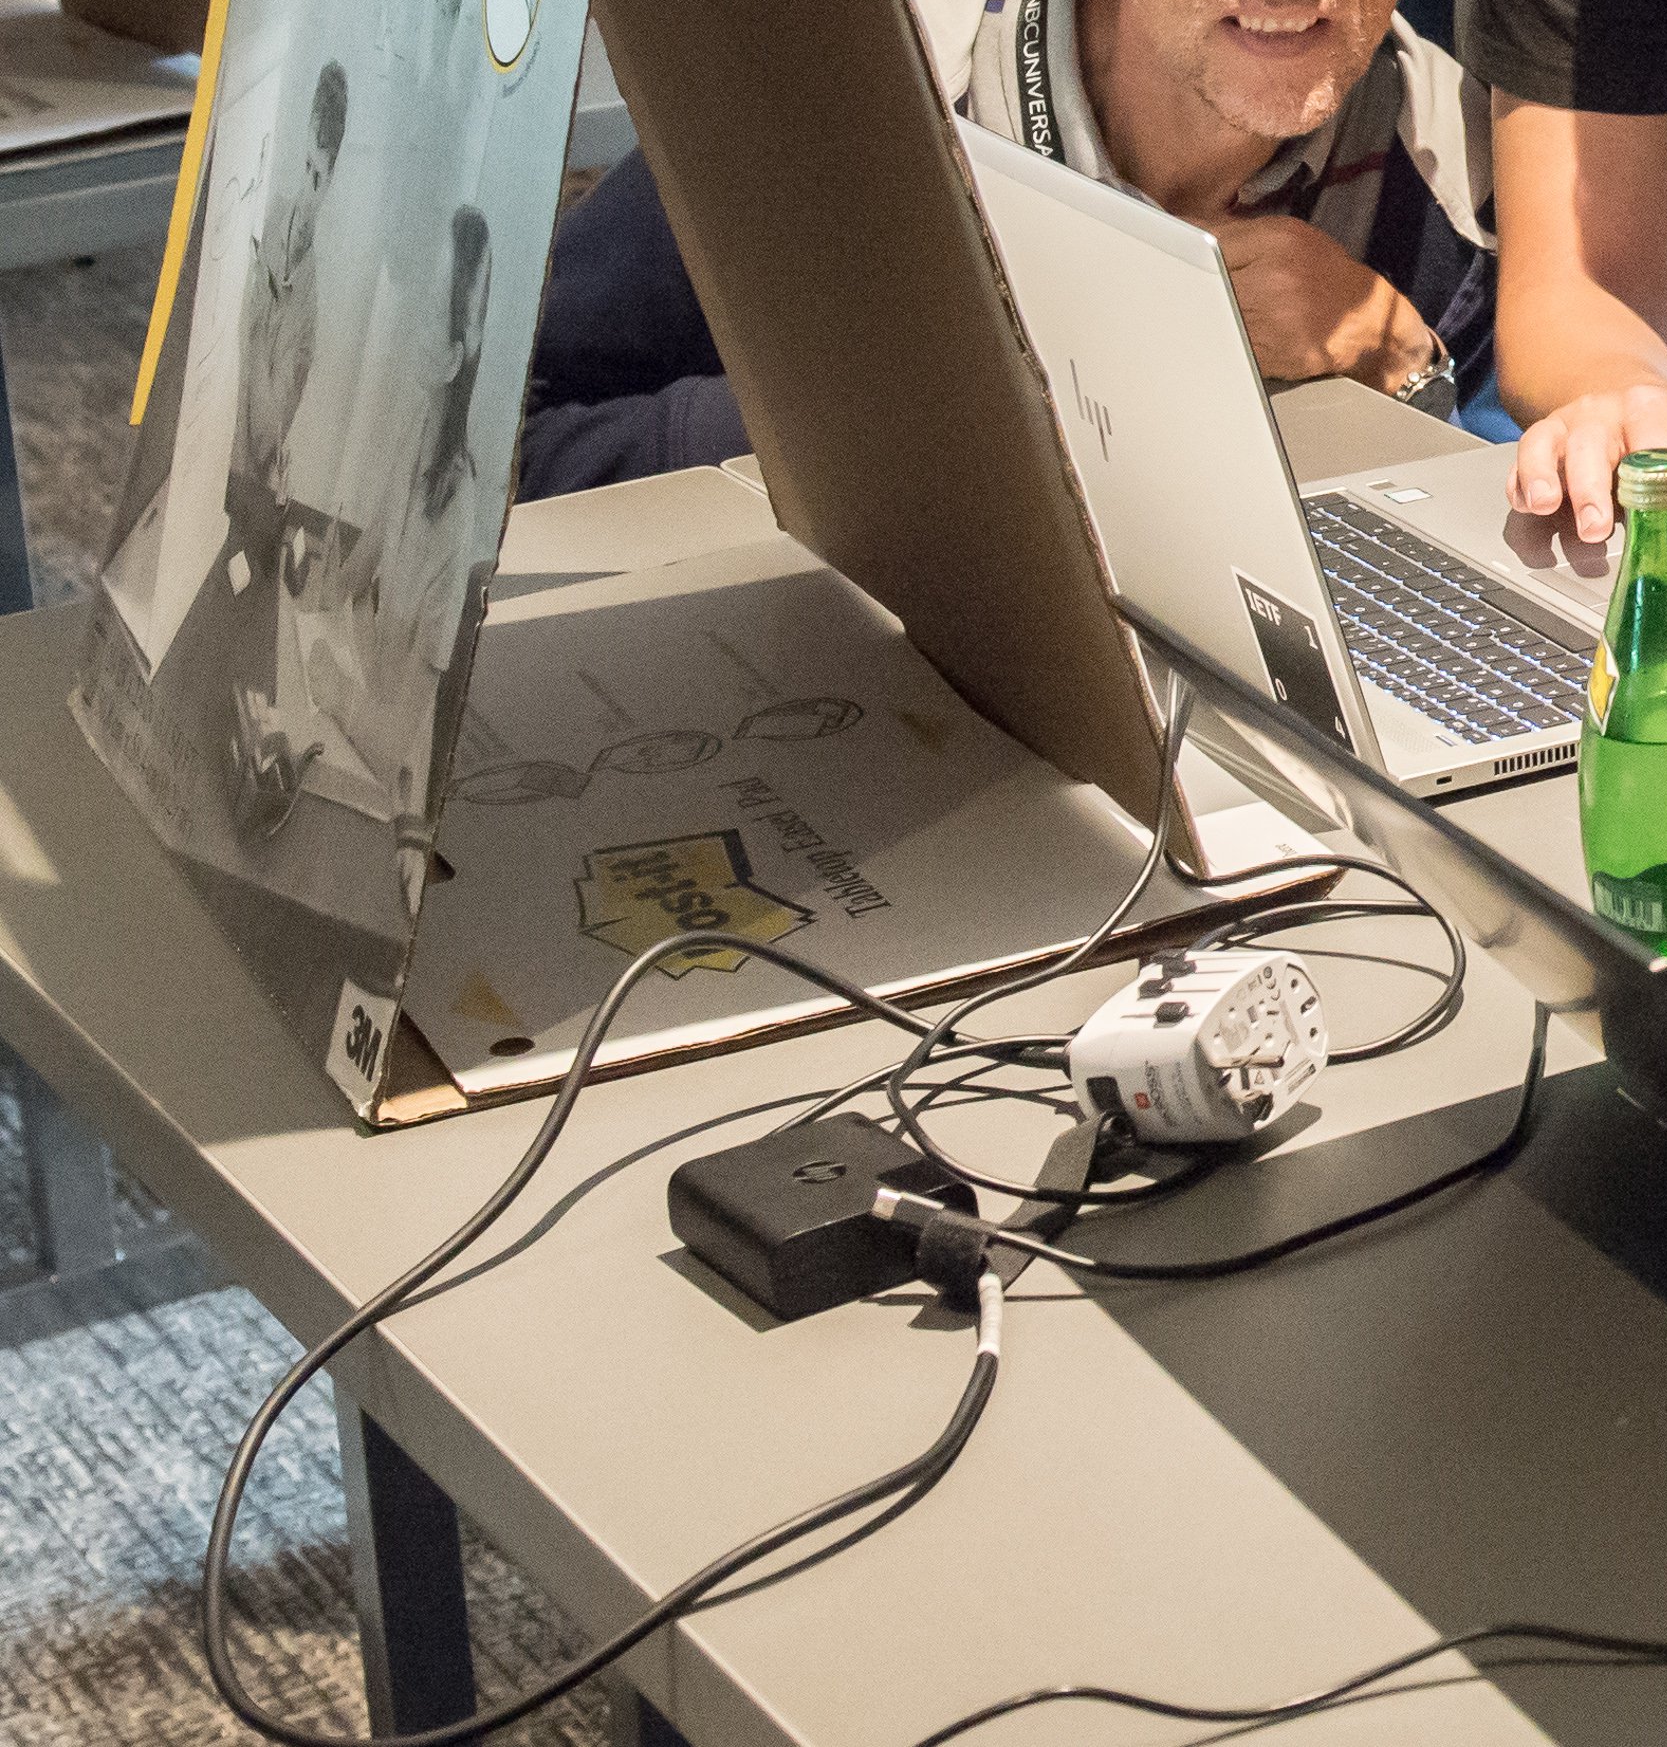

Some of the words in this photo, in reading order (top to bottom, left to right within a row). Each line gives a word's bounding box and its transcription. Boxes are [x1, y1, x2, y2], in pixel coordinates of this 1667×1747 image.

[1244, 588, 1282, 627] IETF
[717, 776, 782, 809] Pad
[752, 809, 826, 854] Easel
[609, 851, 731, 932] ost-it
[808, 850, 892, 920] Tabletop
[345, 1003, 383, 1083] 3M
